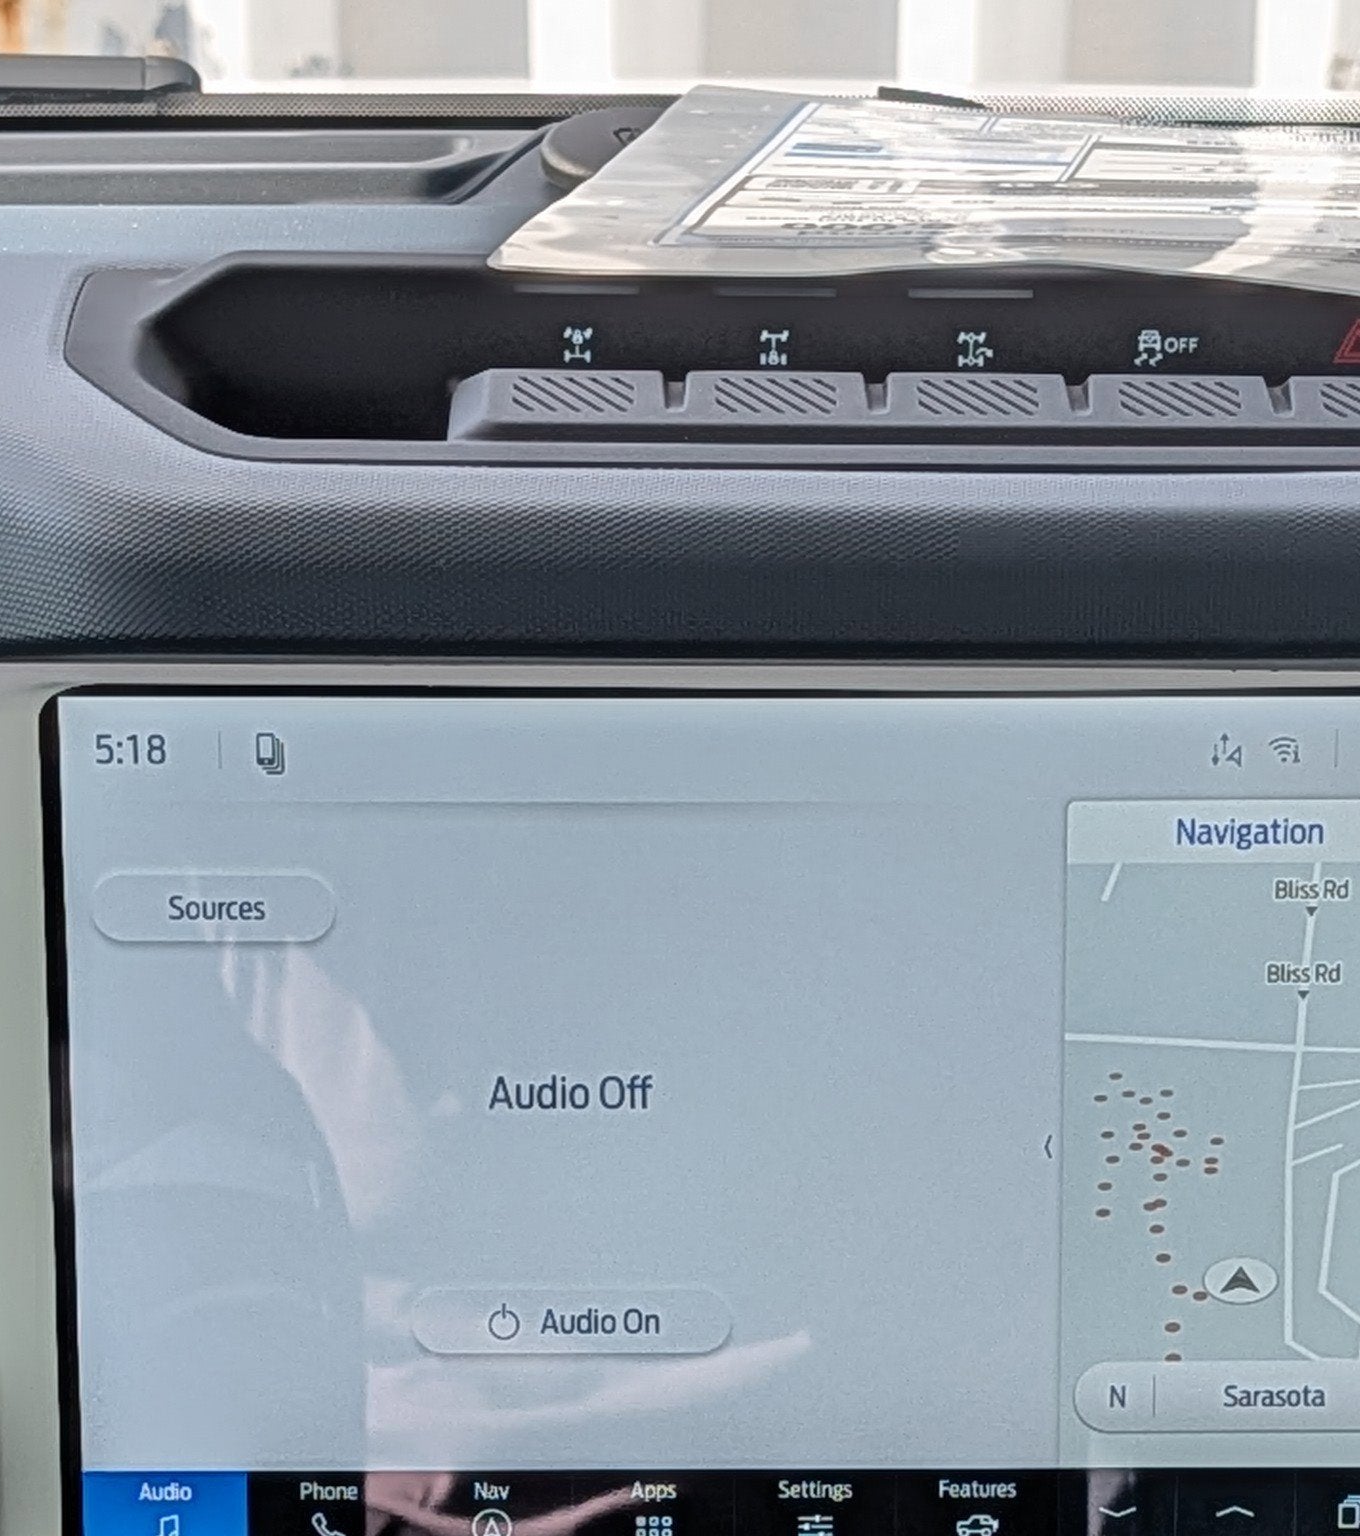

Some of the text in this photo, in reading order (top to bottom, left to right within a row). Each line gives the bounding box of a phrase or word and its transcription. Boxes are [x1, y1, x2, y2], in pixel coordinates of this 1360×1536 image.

[1163, 336, 1200, 354] OFF
[94, 733, 168, 766] 5:18
[1175, 817, 1325, 850] Navigation
[1274, 879, 1350, 900] Bliss Rd
[167, 894, 266, 922] Sources
[1265, 963, 1342, 984] Bliss Rd
[488, 1074, 654, 1110] Audio Off
[540, 1307, 661, 1335] Audio On
[1108, 1385, 1127, 1408] N
[1222, 1384, 1327, 1408] Sarasota
[139, 1481, 193, 1503] Audio
[299, 1481, 359, 1502] Phone
[473, 1481, 510, 1501] Nav
[630, 1481, 677, 1502] Apps
[777, 1478, 854, 1502] Settings
[938, 1478, 1018, 1499] Features
